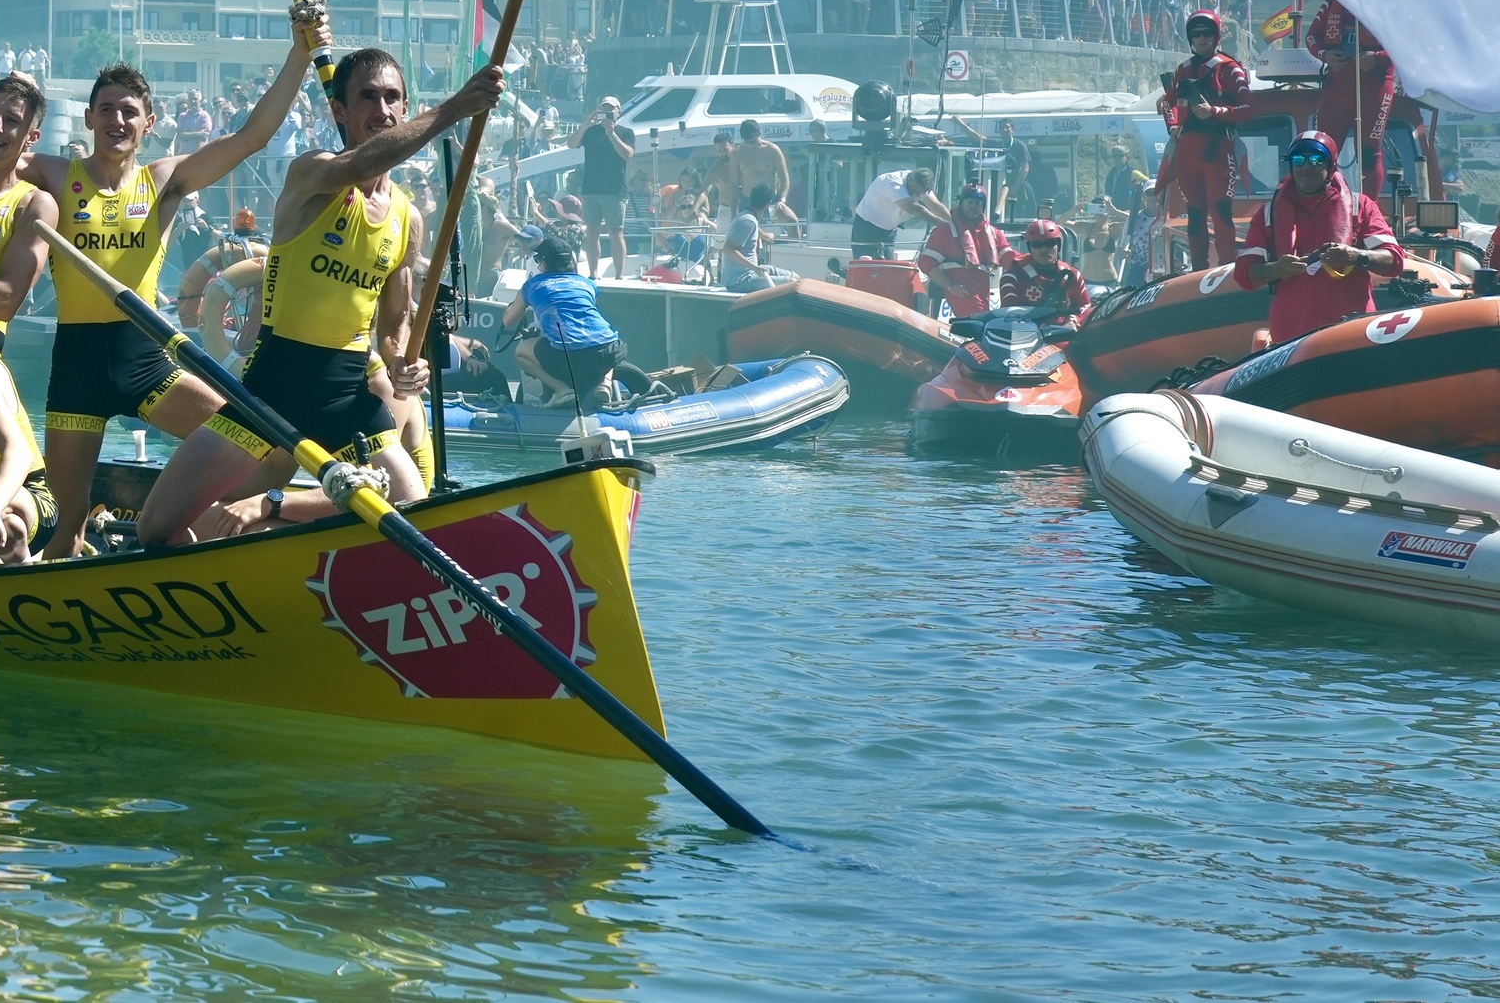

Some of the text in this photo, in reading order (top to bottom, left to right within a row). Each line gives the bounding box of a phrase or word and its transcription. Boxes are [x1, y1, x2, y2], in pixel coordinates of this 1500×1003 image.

[1369, 93, 1392, 140] RESCATE
[74, 232, 146, 250] ORIALKI
[265, 254, 280, 303] Loiola
[310, 254, 383, 292] ORIALKI
[1402, 535, 1472, 557] NARWHAL
[4, 640, 256, 663] Euskal Sukaldariak
